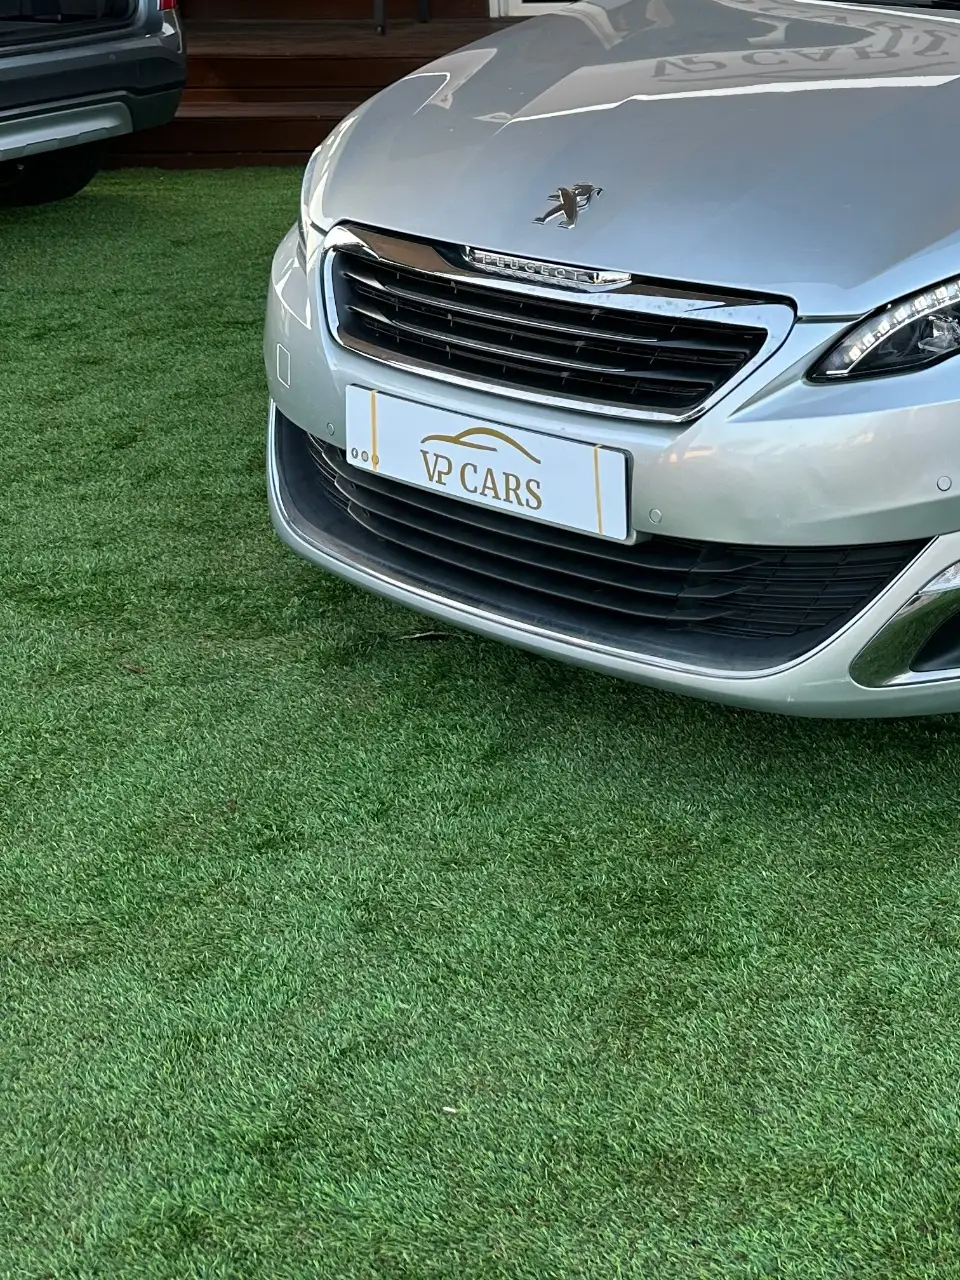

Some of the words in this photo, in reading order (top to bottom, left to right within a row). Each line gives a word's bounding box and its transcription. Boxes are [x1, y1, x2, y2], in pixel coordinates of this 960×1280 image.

[481, 254, 583, 280] PEUGEOT
[420, 449, 453, 486] VP
[460, 462, 543, 510] CARS
